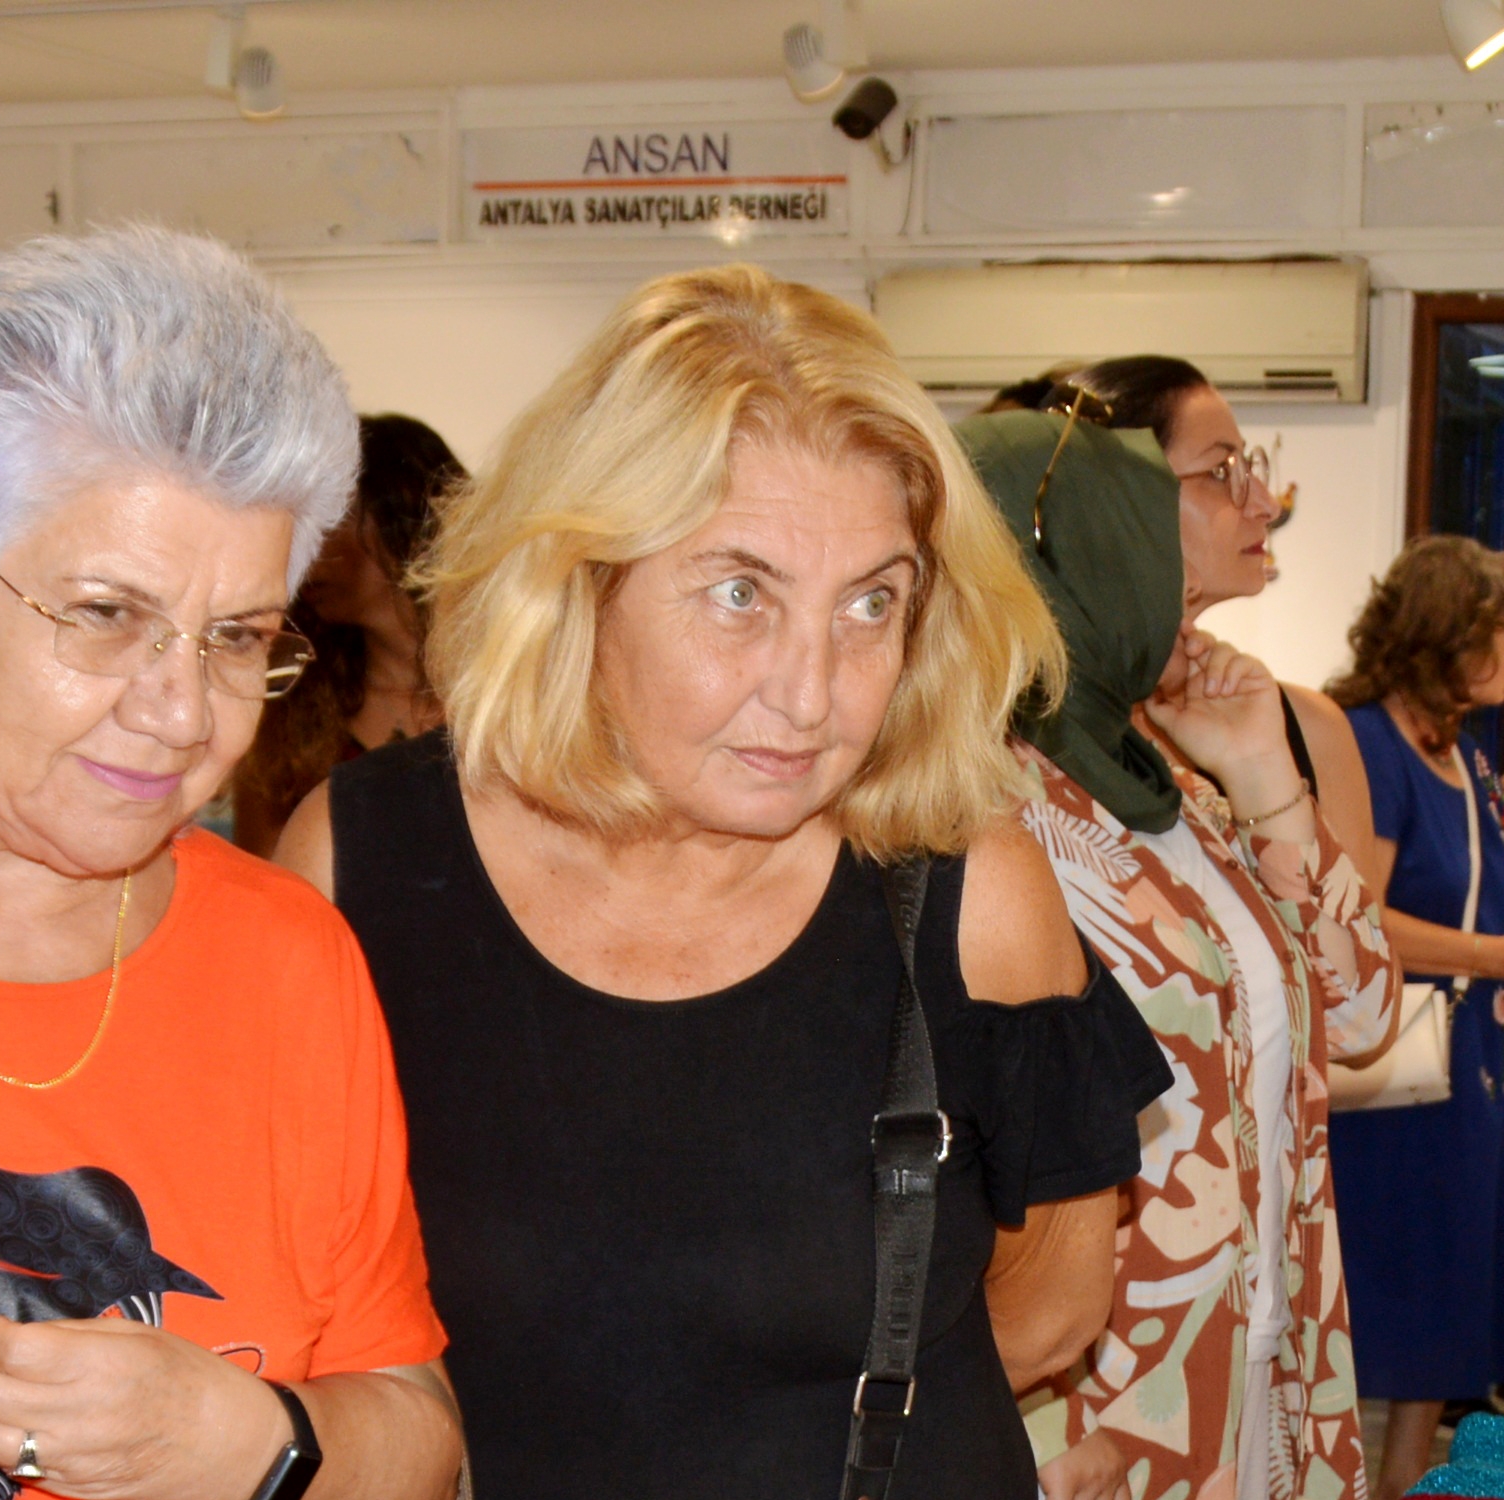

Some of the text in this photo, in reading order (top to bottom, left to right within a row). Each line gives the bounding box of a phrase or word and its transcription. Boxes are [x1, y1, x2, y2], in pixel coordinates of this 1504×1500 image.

[584, 132, 729, 174] ANSAN
[479, 197, 576, 226] ANTALYA
[583, 193, 722, 229] SANATÇILAR
